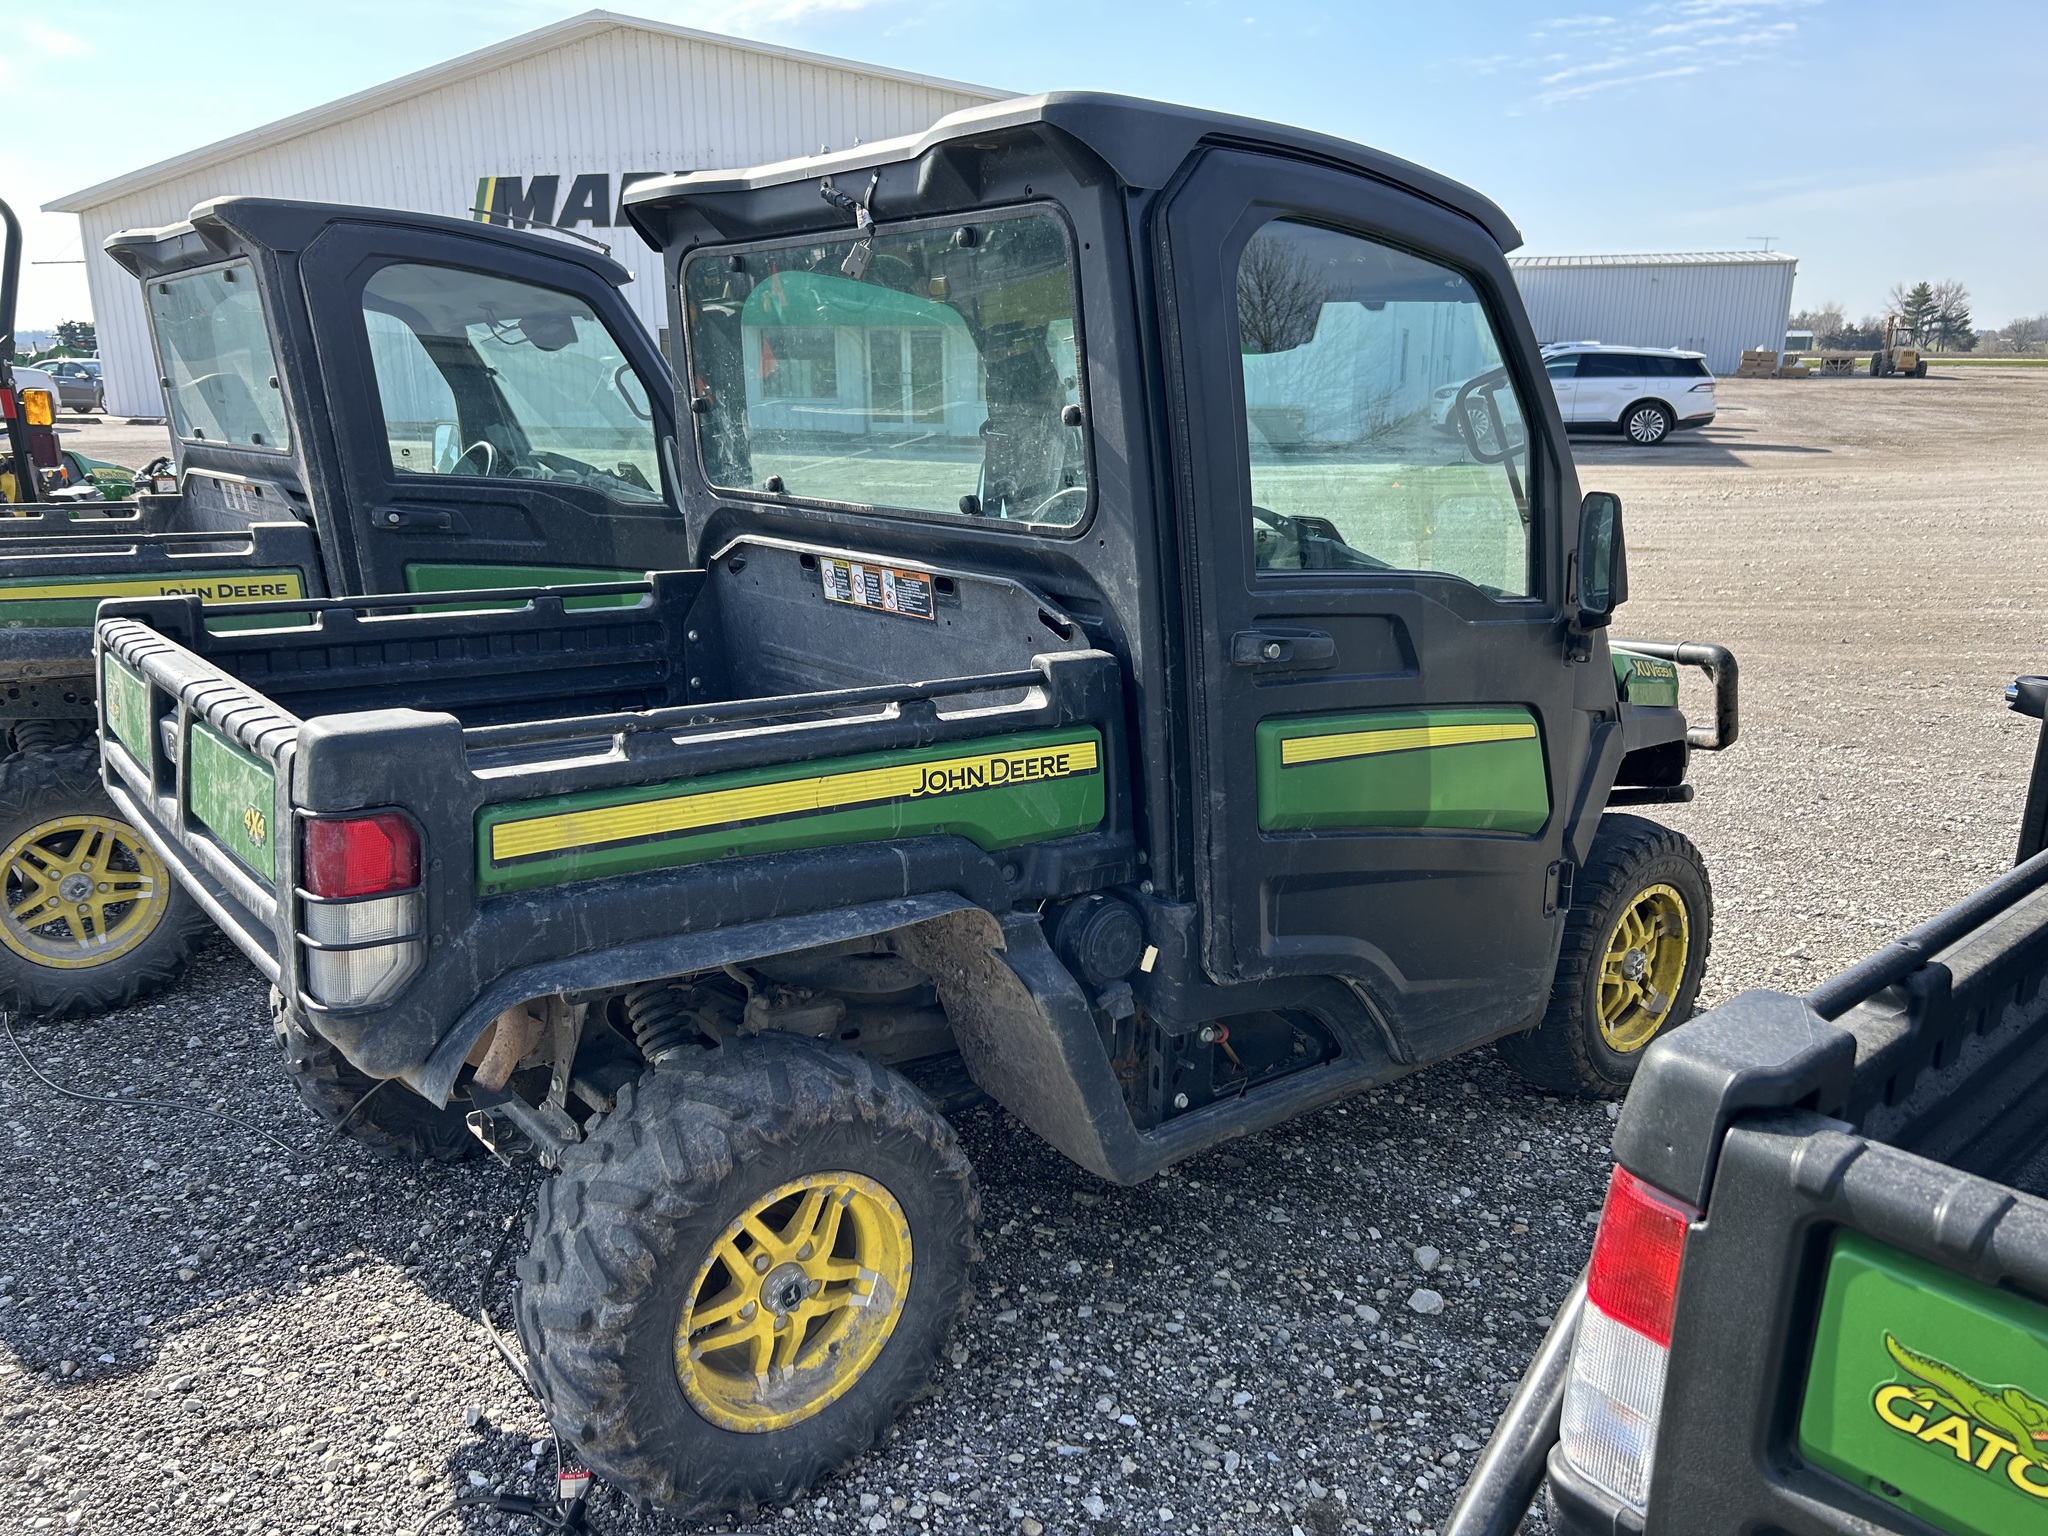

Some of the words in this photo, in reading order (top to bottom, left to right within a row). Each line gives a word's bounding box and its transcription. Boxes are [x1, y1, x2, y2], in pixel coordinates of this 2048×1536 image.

[217, 583, 288, 599] DEERE
[912, 765, 984, 794] JOHN
[990, 753, 1070, 782] DEERE
